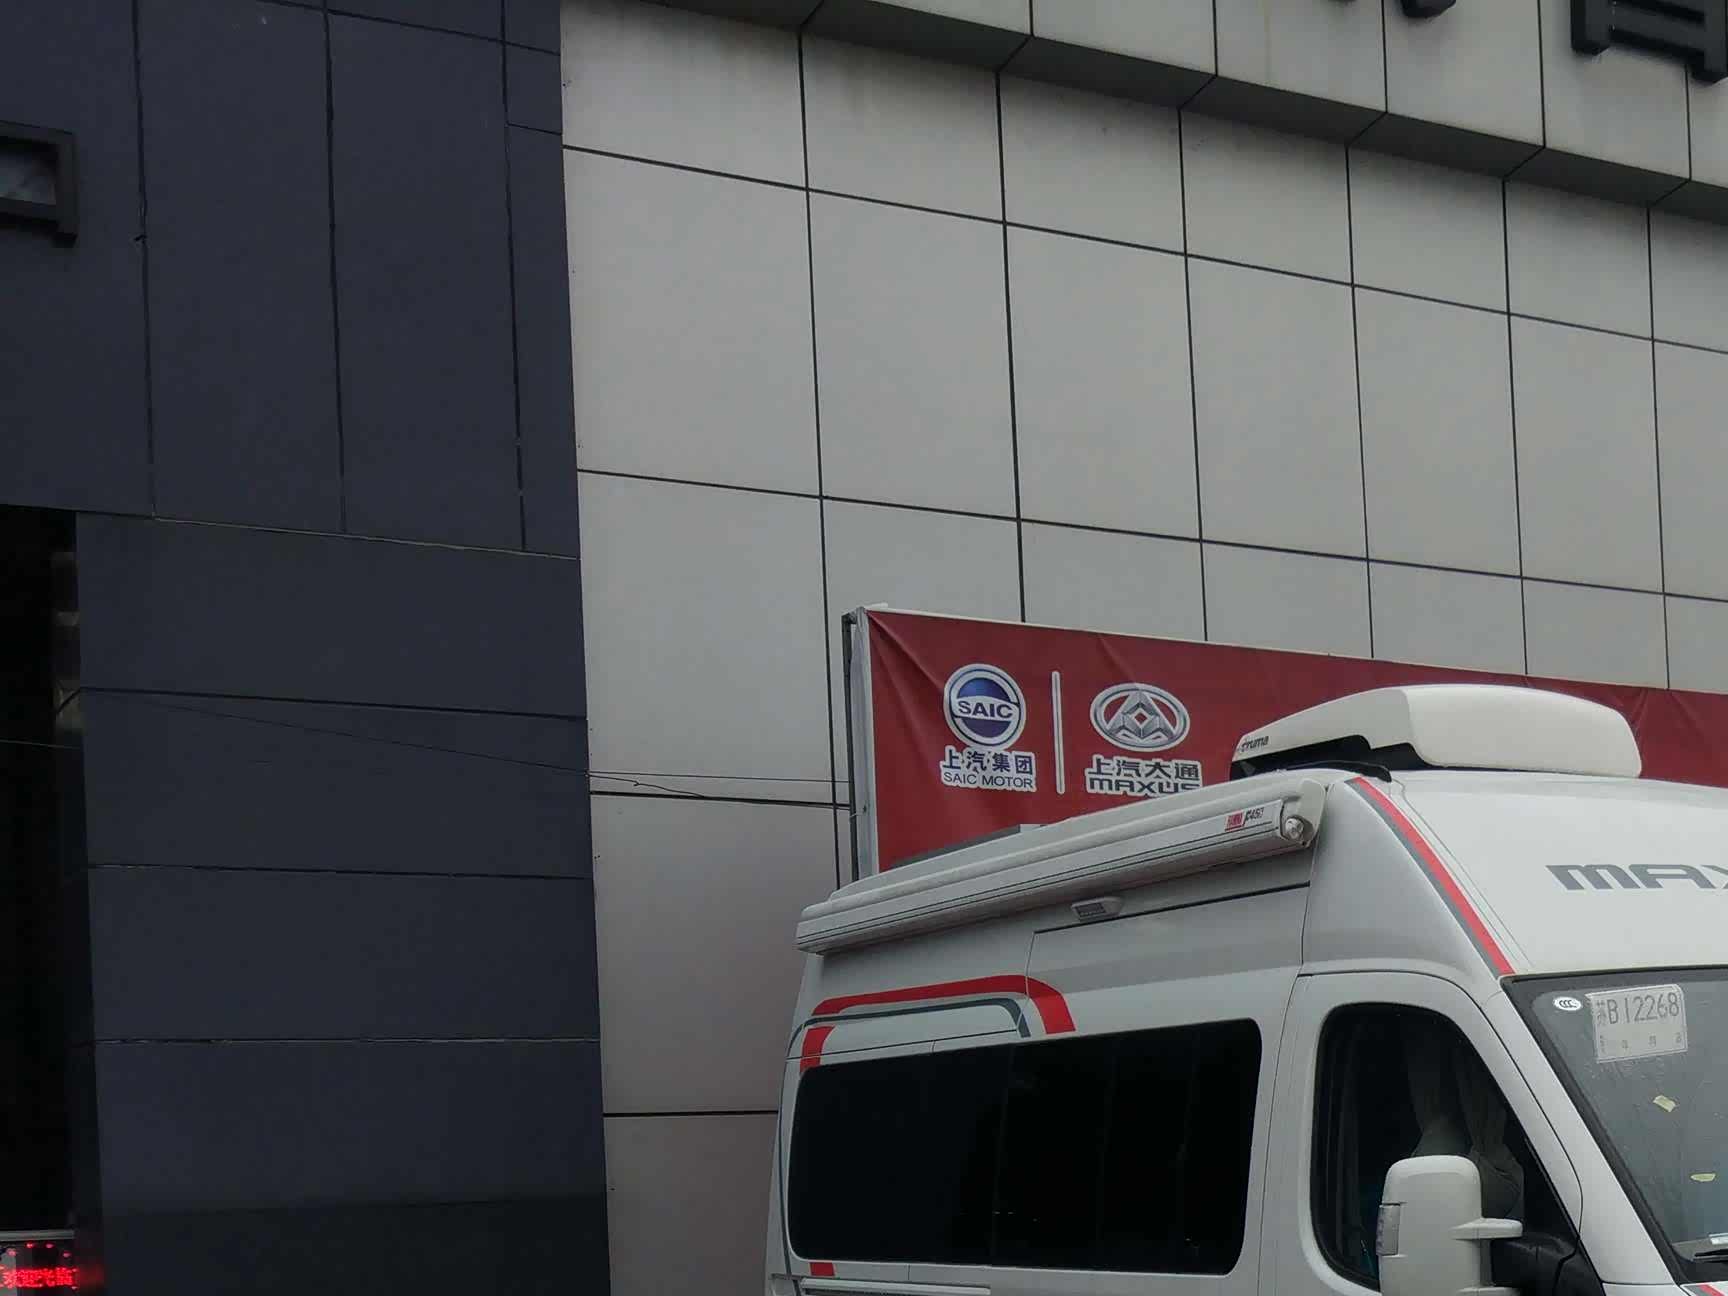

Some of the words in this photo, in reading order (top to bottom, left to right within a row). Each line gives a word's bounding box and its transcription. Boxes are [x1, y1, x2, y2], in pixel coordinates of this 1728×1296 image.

[957, 701, 1014, 719] SAIC
[942, 749, 1033, 775] 上汽集团
[1087, 757, 1201, 781] 上汽大通
[943, 771, 977, 785] SAIC
[981, 775, 1033, 789] MOTOR
